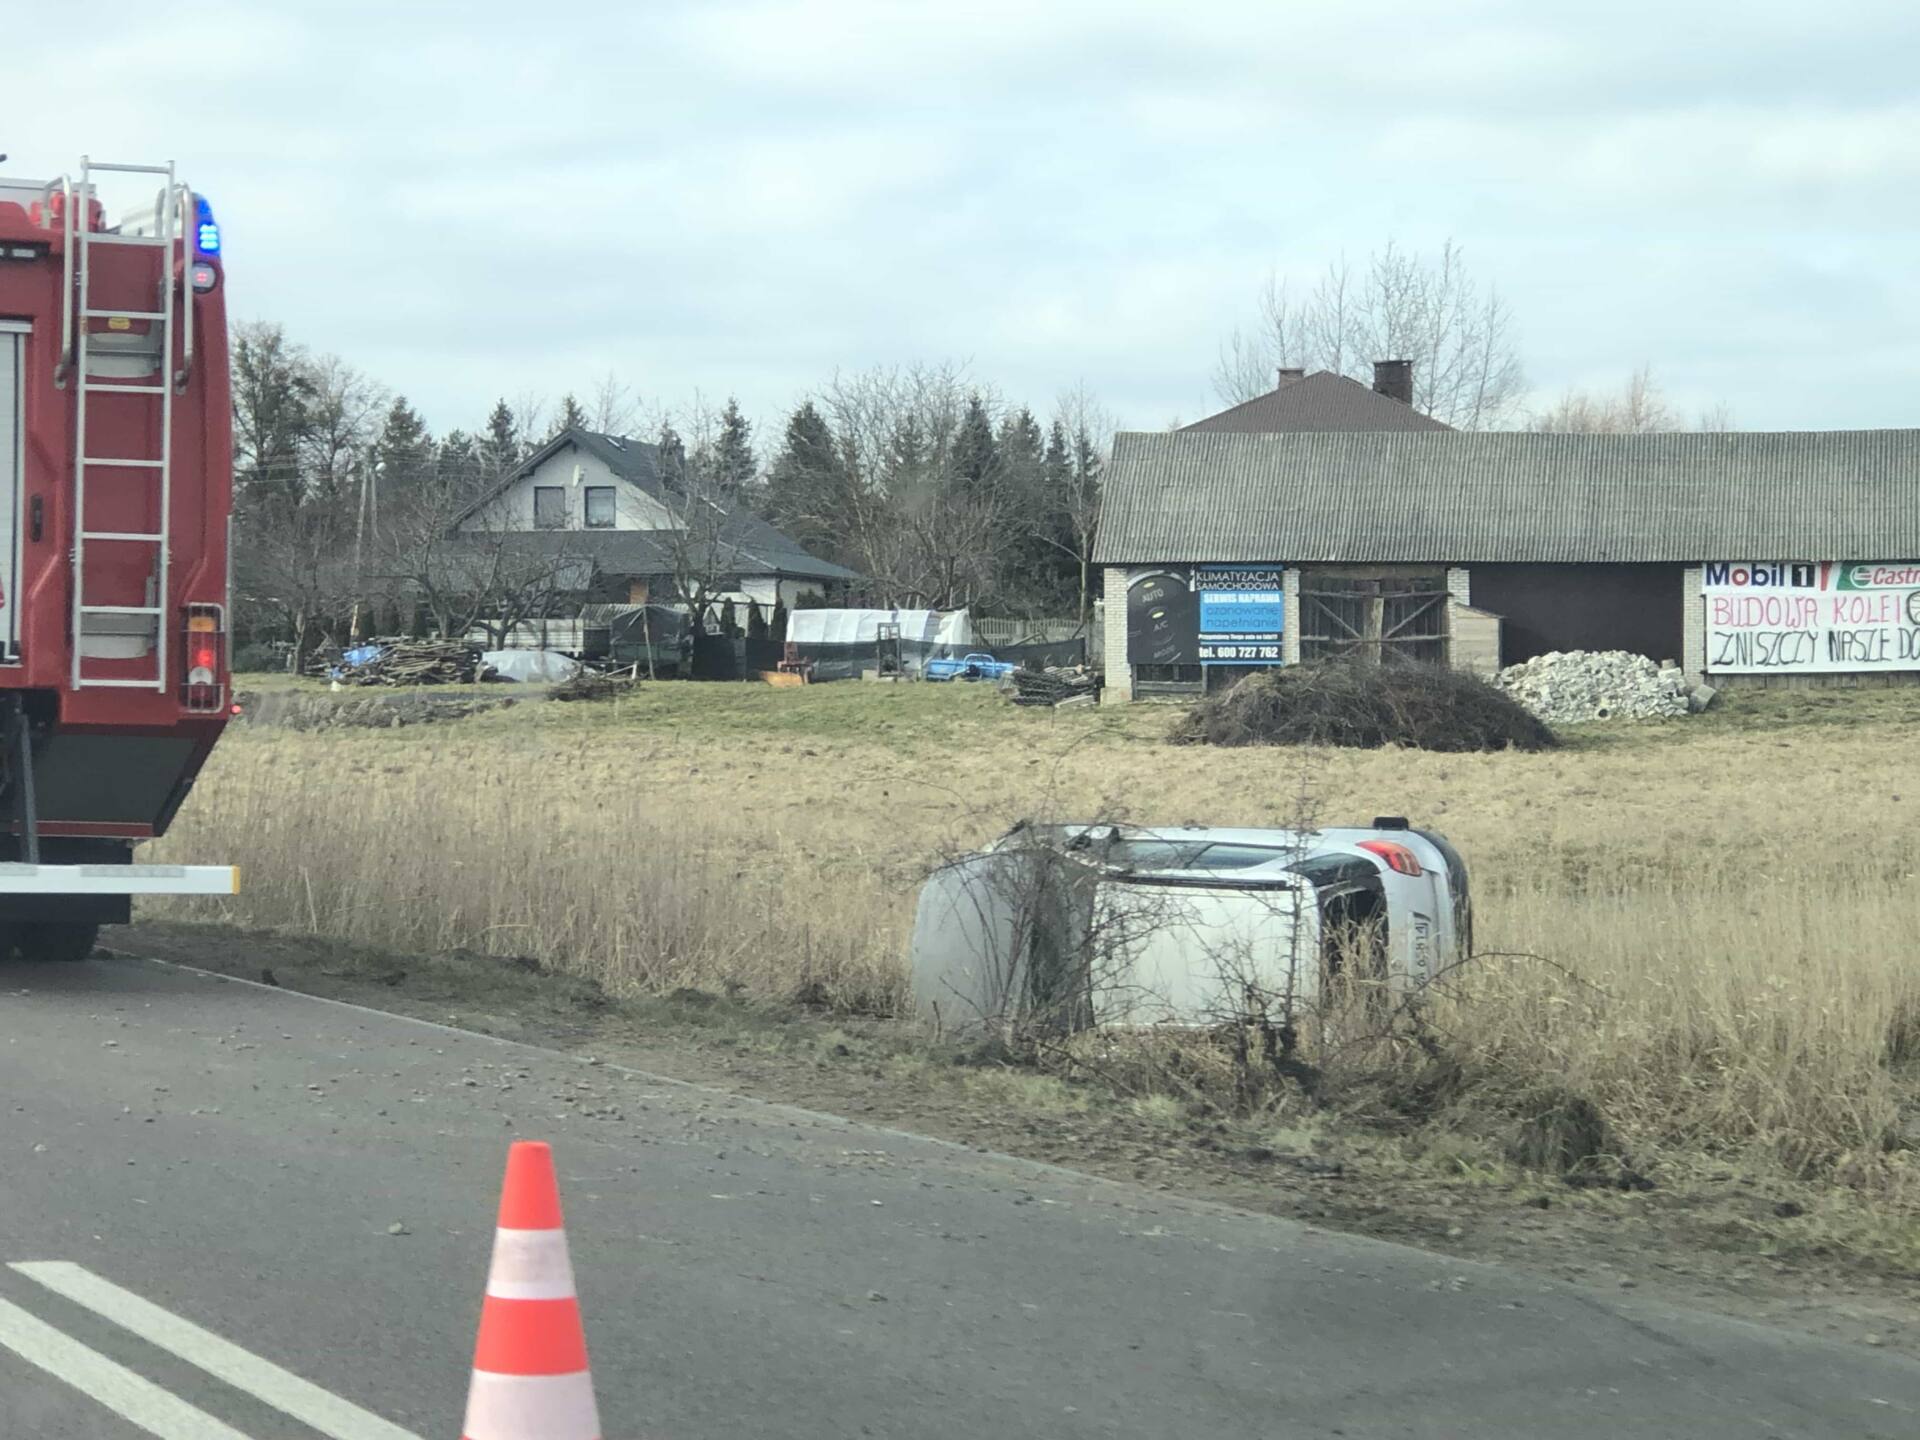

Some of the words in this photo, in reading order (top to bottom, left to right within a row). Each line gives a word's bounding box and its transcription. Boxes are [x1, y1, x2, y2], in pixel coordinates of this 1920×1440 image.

[1196, 571, 1279, 581] KLIMATYZACJA
[1706, 564, 1785, 586] Mobil
[1196, 582, 1279, 590] SAMOCHODOWA
[1142, 588, 1165, 603] AUTO
[1713, 596, 1819, 627] BUDOWA
[1832, 594, 1901, 624] KOLEI
[1152, 620, 1169, 632] A/C
[1199, 647, 1215, 658] tel.
[1239, 647, 1256, 658] 727
[1259, 647, 1279, 658] 762
[1712, 631, 1819, 667] ZNISZCZY
[1828, 628, 1892, 662] NASZE
